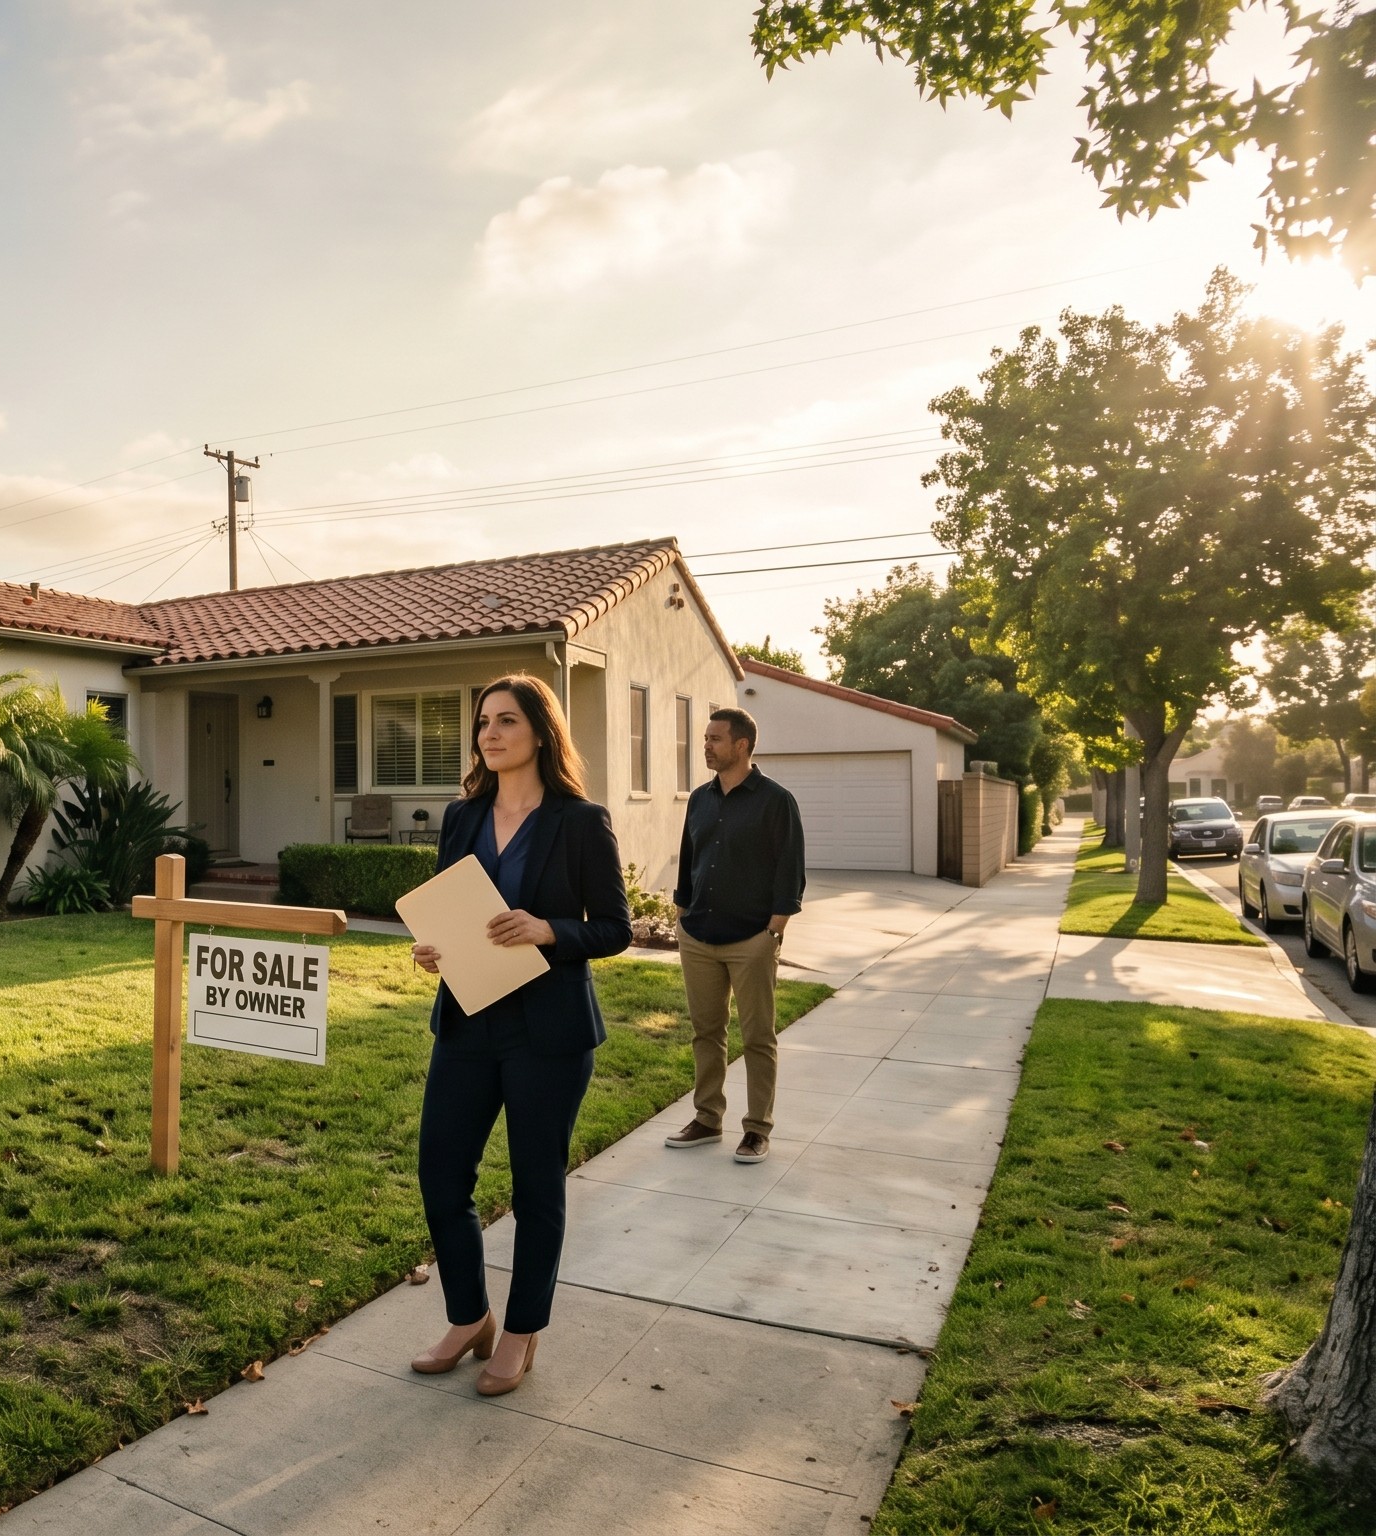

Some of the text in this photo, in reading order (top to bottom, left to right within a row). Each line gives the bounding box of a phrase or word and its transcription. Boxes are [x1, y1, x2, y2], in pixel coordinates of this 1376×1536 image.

[196, 945, 319, 992] FOR SALE
[205, 985, 306, 1020] BY OWNER
